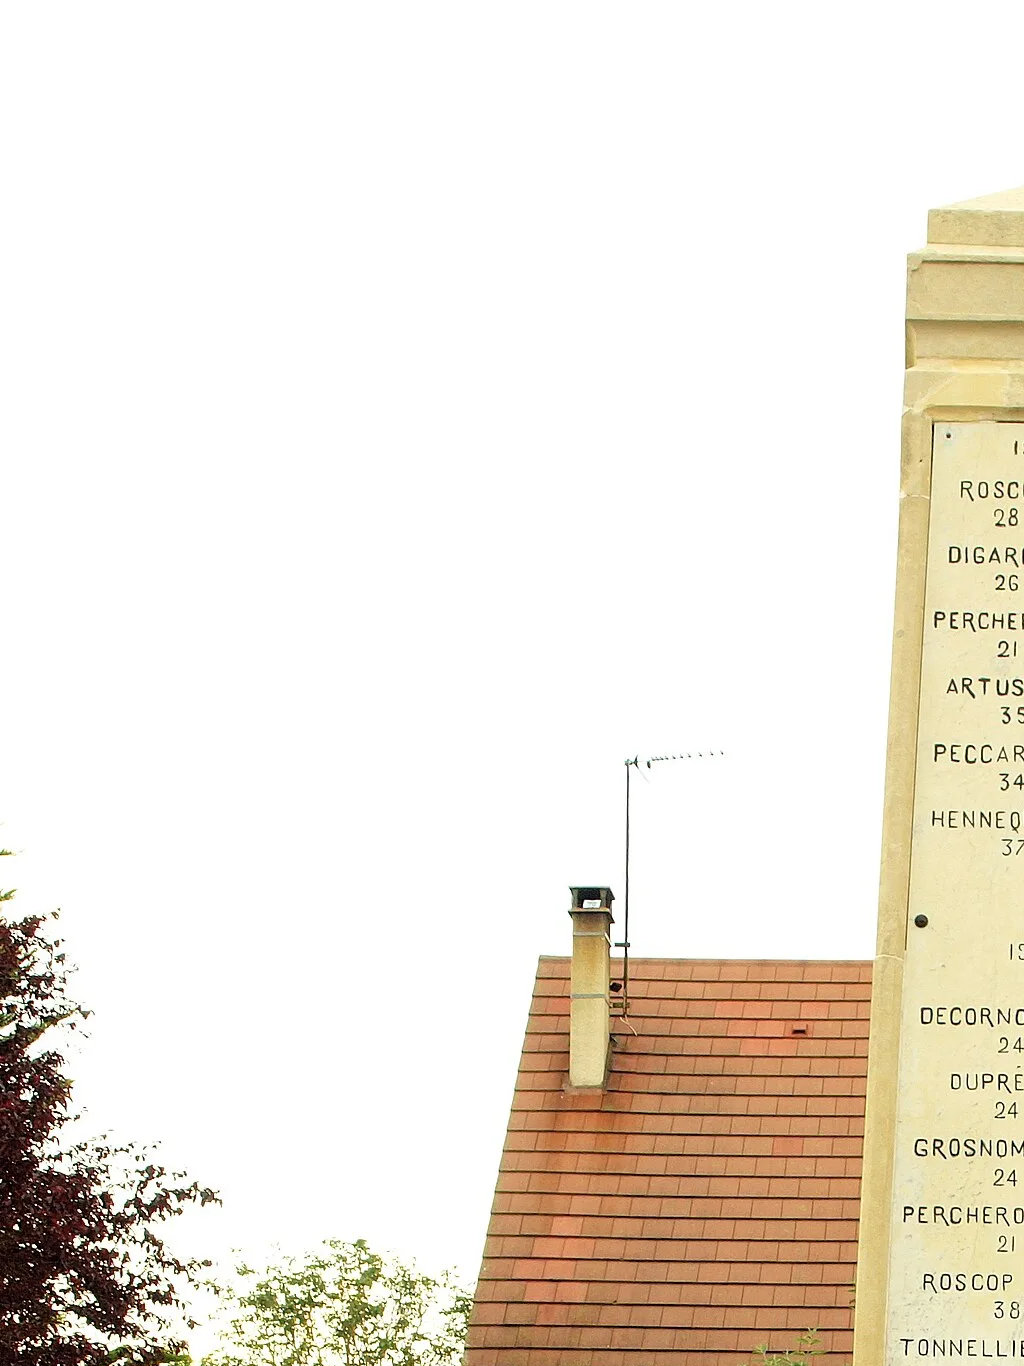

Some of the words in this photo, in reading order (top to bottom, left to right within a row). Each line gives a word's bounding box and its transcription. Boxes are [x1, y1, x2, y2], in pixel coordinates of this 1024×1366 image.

[994, 508, 1018, 527] 28
[995, 575, 1018, 591] 26
[997, 641, 1016, 657] 21
[946, 678, 1024, 699] ARTUS
[999, 773, 1024, 791] 34
[998, 1037, 1024, 1053] 24
[951, 1066, 1024, 1094] DUPRÉ
[994, 1102, 1018, 1119] 24
[914, 1138, 1024, 1159] GROSNOM
[993, 1169, 1017, 1187] 24
[997, 1235, 1014, 1252] 21
[923, 1274, 1012, 1294] ROSCOP
[994, 1301, 1020, 1319] 38
